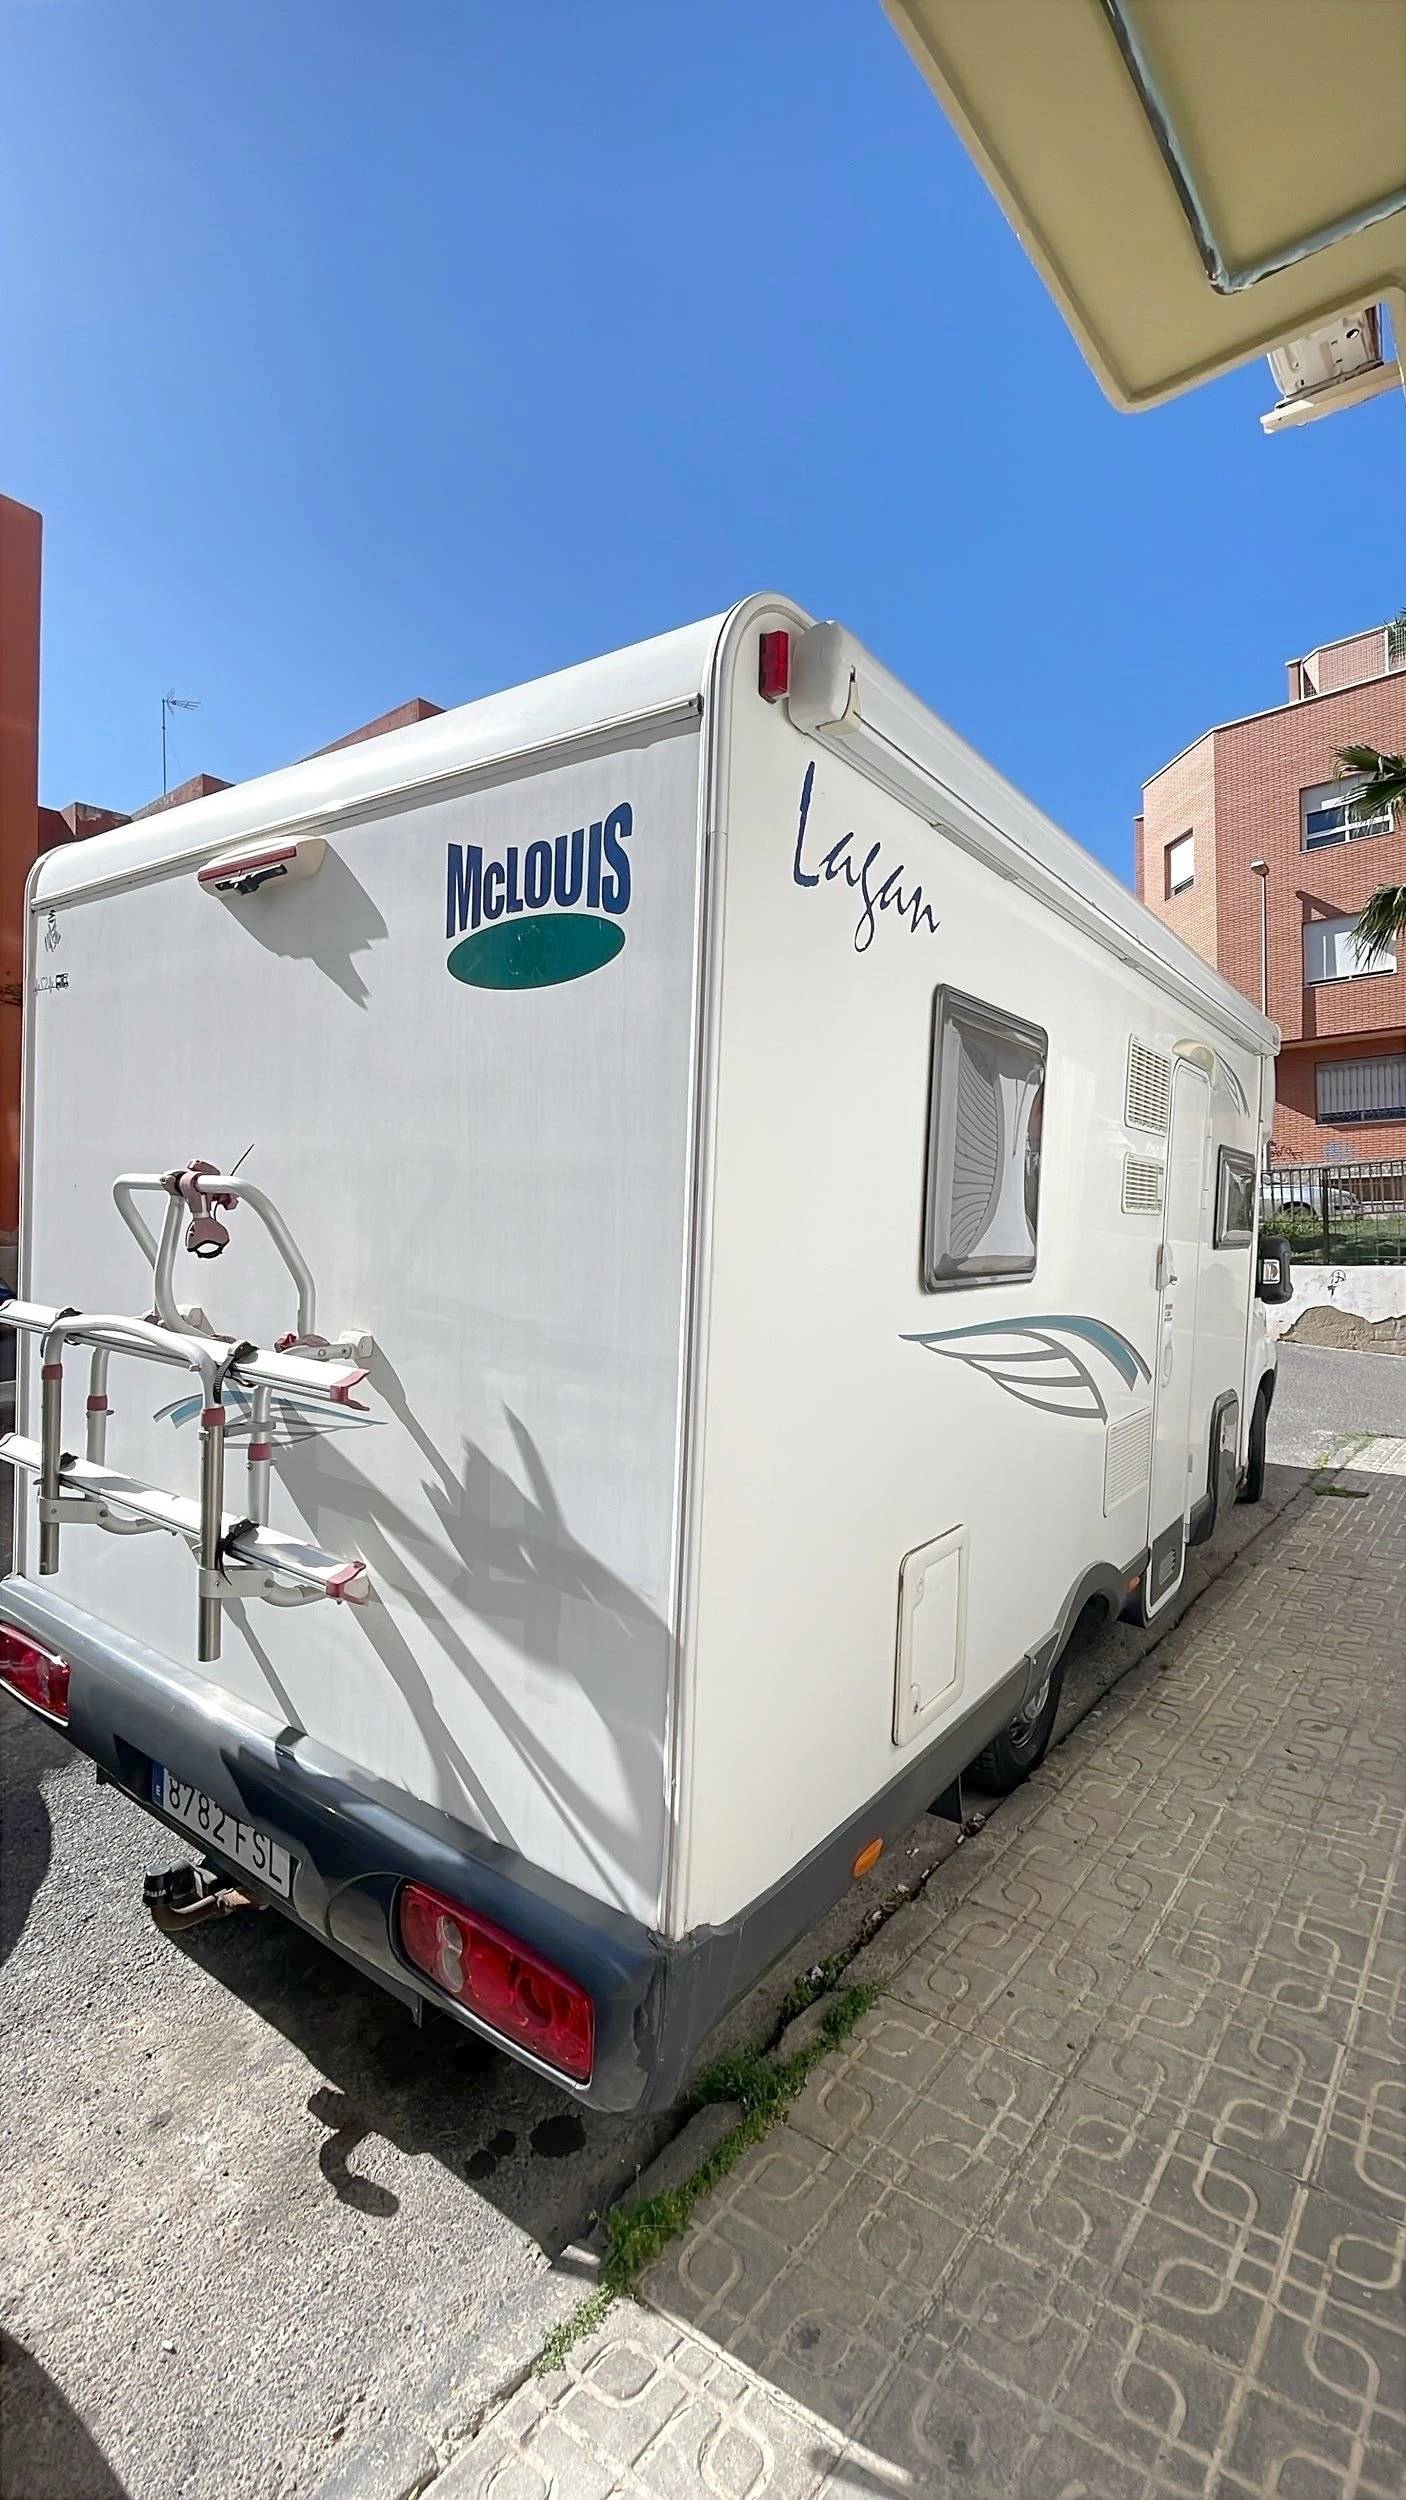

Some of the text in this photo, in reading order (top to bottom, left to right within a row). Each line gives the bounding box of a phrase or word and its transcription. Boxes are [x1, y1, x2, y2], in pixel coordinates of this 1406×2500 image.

[446, 802, 632, 939] McLOUIS
[794, 760, 941, 952] Lagan
[169, 1776, 225, 1844] 8782
[234, 1818, 283, 1885] FSL
